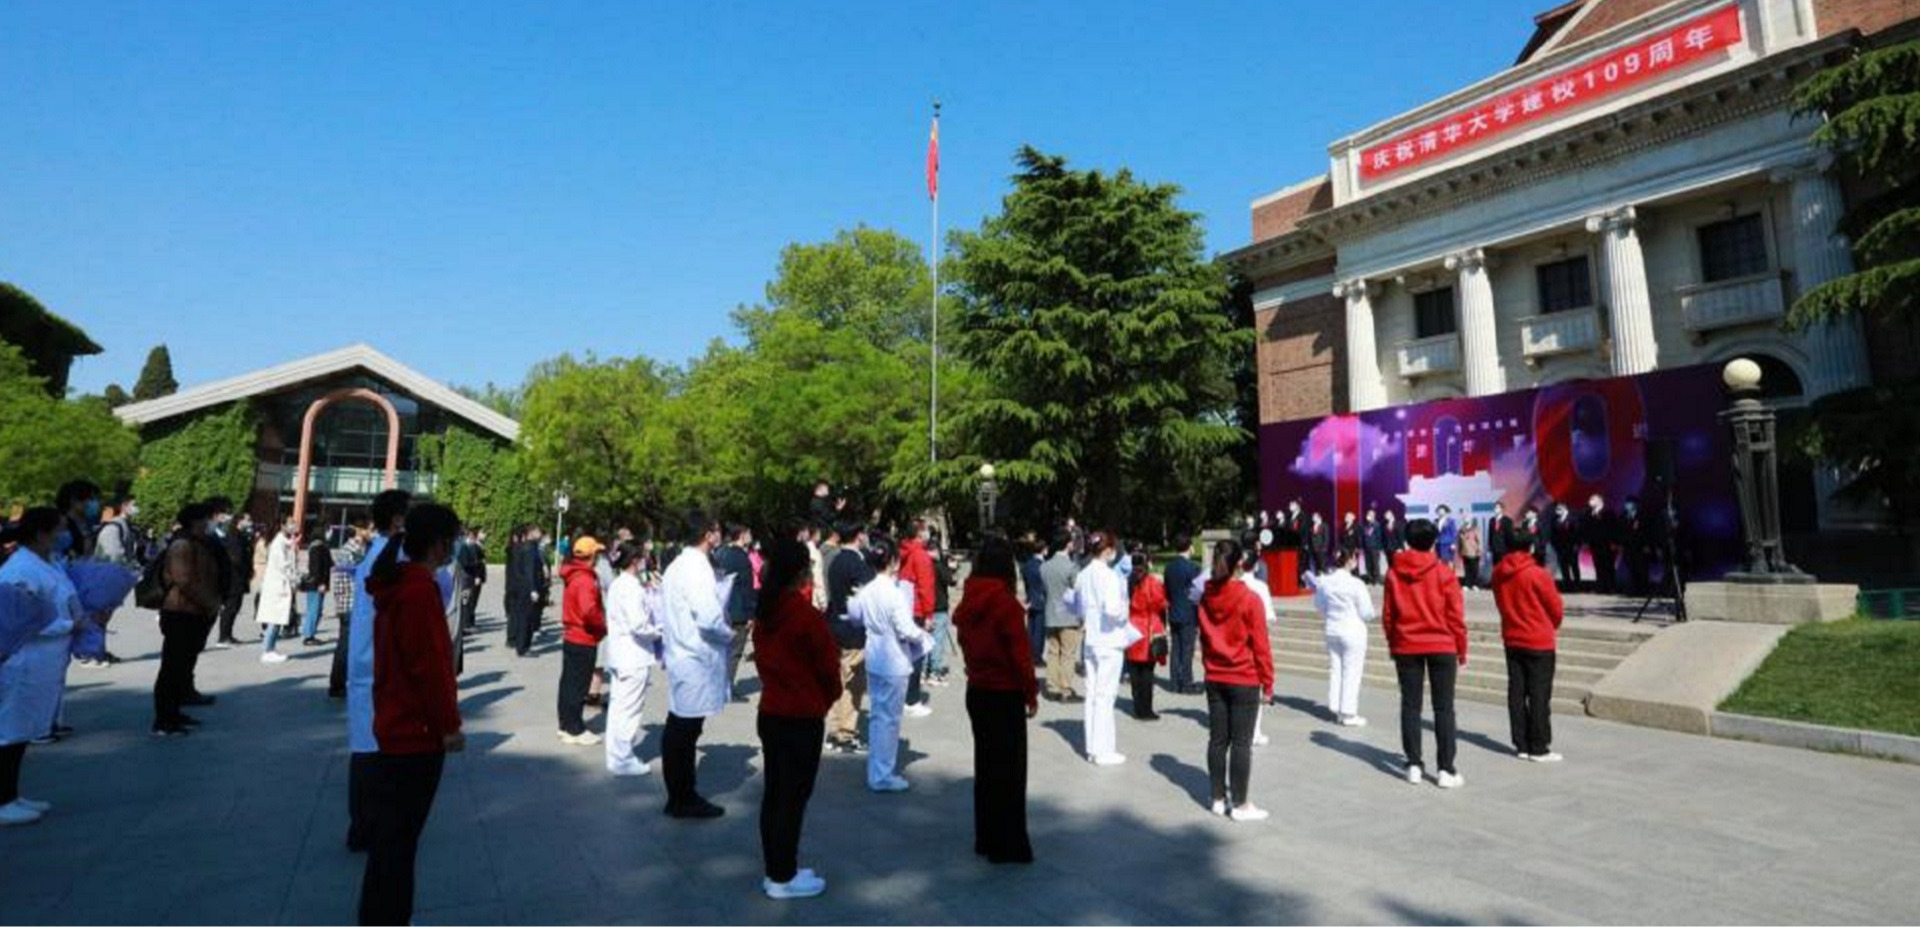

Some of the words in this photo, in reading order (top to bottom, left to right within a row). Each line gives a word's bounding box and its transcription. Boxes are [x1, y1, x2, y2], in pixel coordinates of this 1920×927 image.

[1373, 25, 1714, 170] 庆祝清华大学建校109周年
